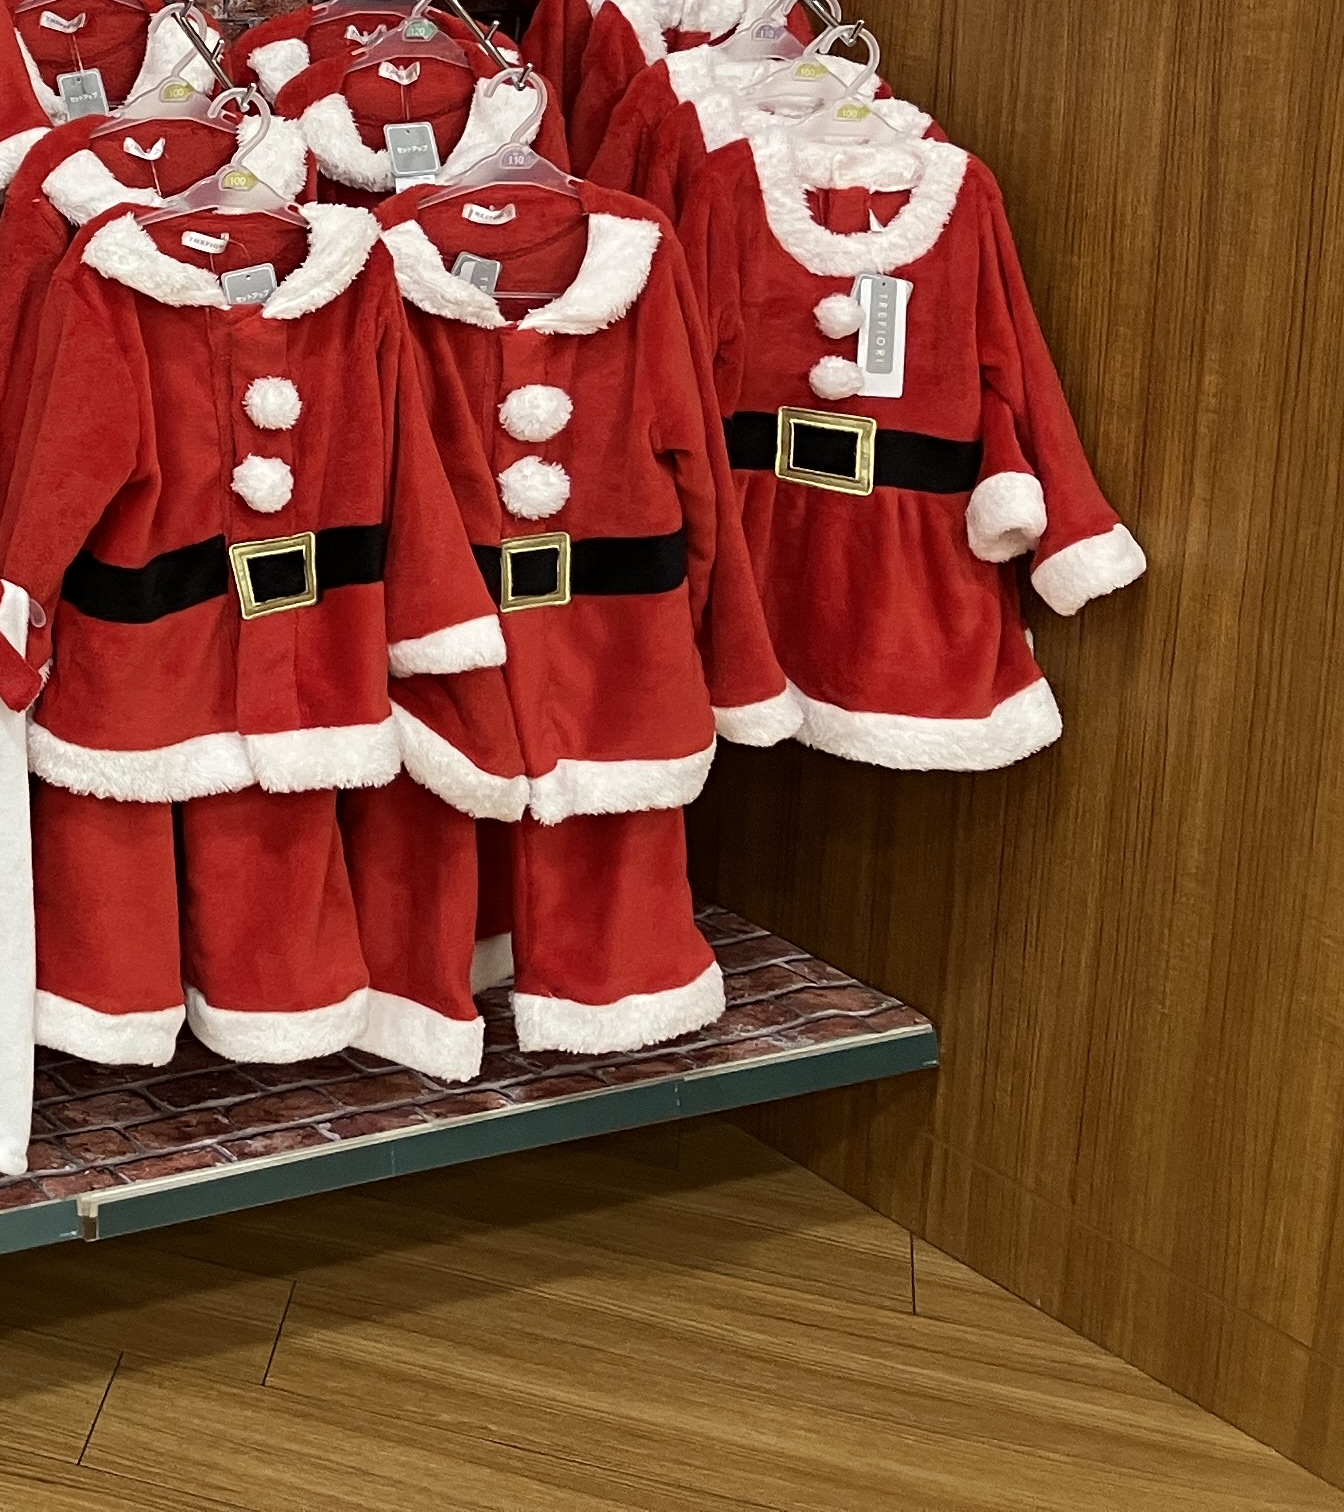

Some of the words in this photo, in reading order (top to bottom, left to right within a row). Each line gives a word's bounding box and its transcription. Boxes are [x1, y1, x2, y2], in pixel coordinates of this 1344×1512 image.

[410, 27, 426, 37] 120
[508, 155, 525, 165] 110
[230, 176, 247, 186] 100
[874, 292, 889, 364] TREFIORI
